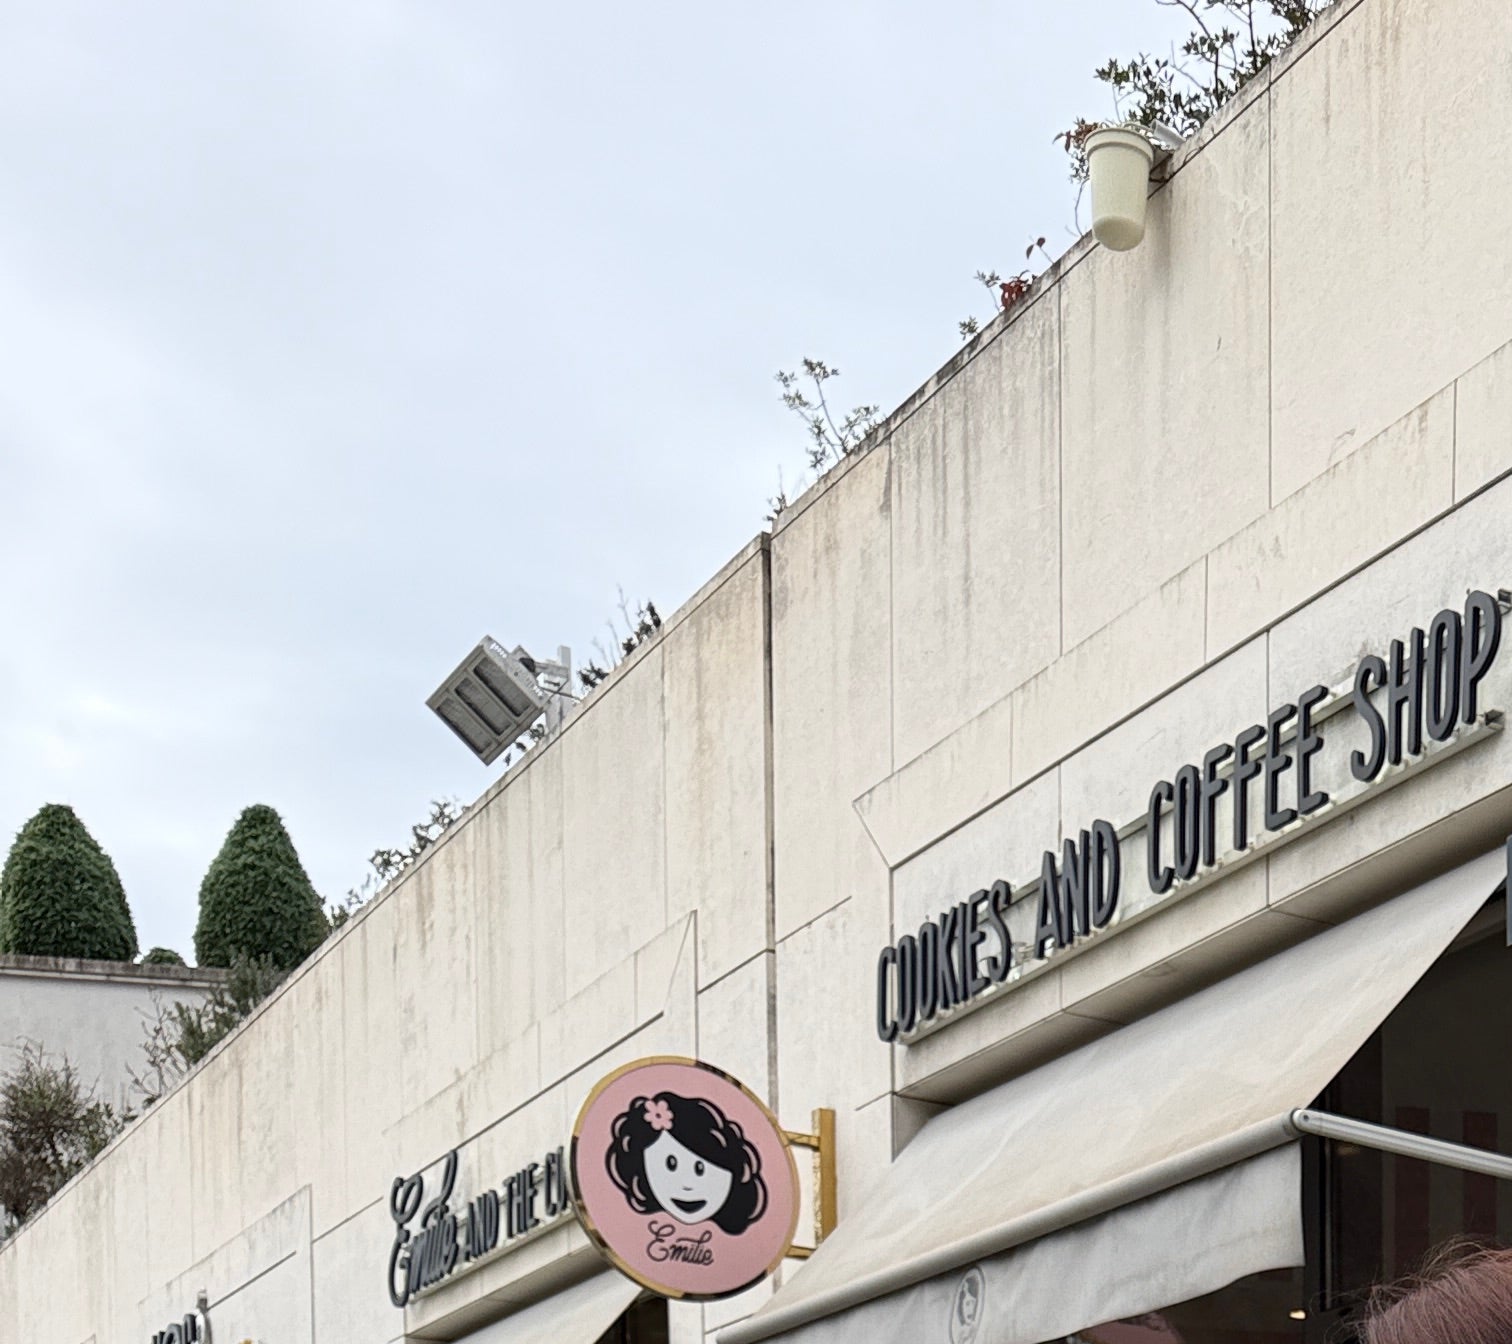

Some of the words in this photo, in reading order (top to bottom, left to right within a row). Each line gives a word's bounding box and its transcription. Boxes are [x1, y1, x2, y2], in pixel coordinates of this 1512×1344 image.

[877, 879, 1013, 1042] COOKIES
[1034, 818, 1120, 960] AND
[1147, 684, 1330, 894] COFFEE
[1351, 590, 1501, 783] SHOP
[464, 1189, 500, 1262] AND
[502, 1162, 541, 1239] THE
[646, 1220, 714, 1267] Emilie
